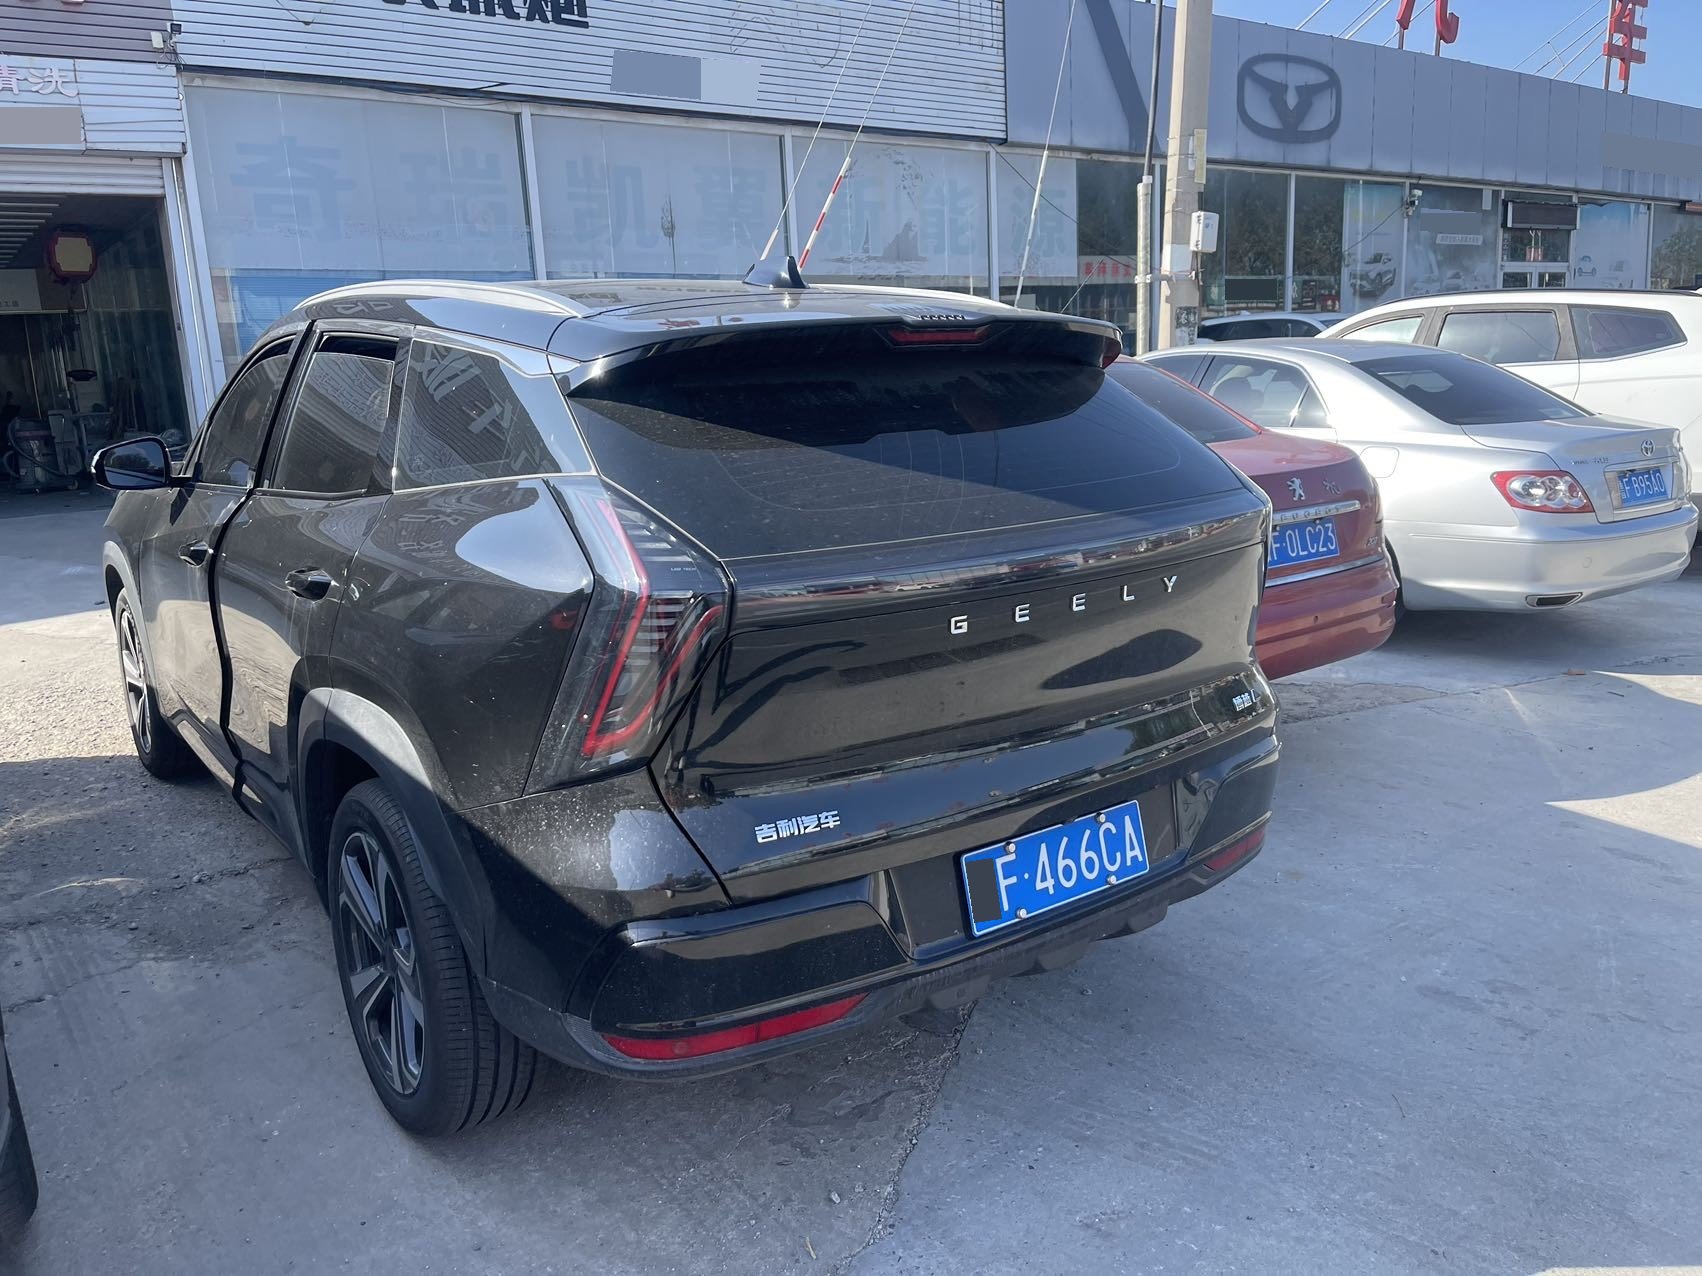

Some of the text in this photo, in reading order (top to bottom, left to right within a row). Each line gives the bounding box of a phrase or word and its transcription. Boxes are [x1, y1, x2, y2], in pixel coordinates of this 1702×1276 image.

[1269, 523, 1336, 561] F·0LC23
[950, 575, 1179, 635] GEELY
[754, 809, 842, 845] 吉利汽车
